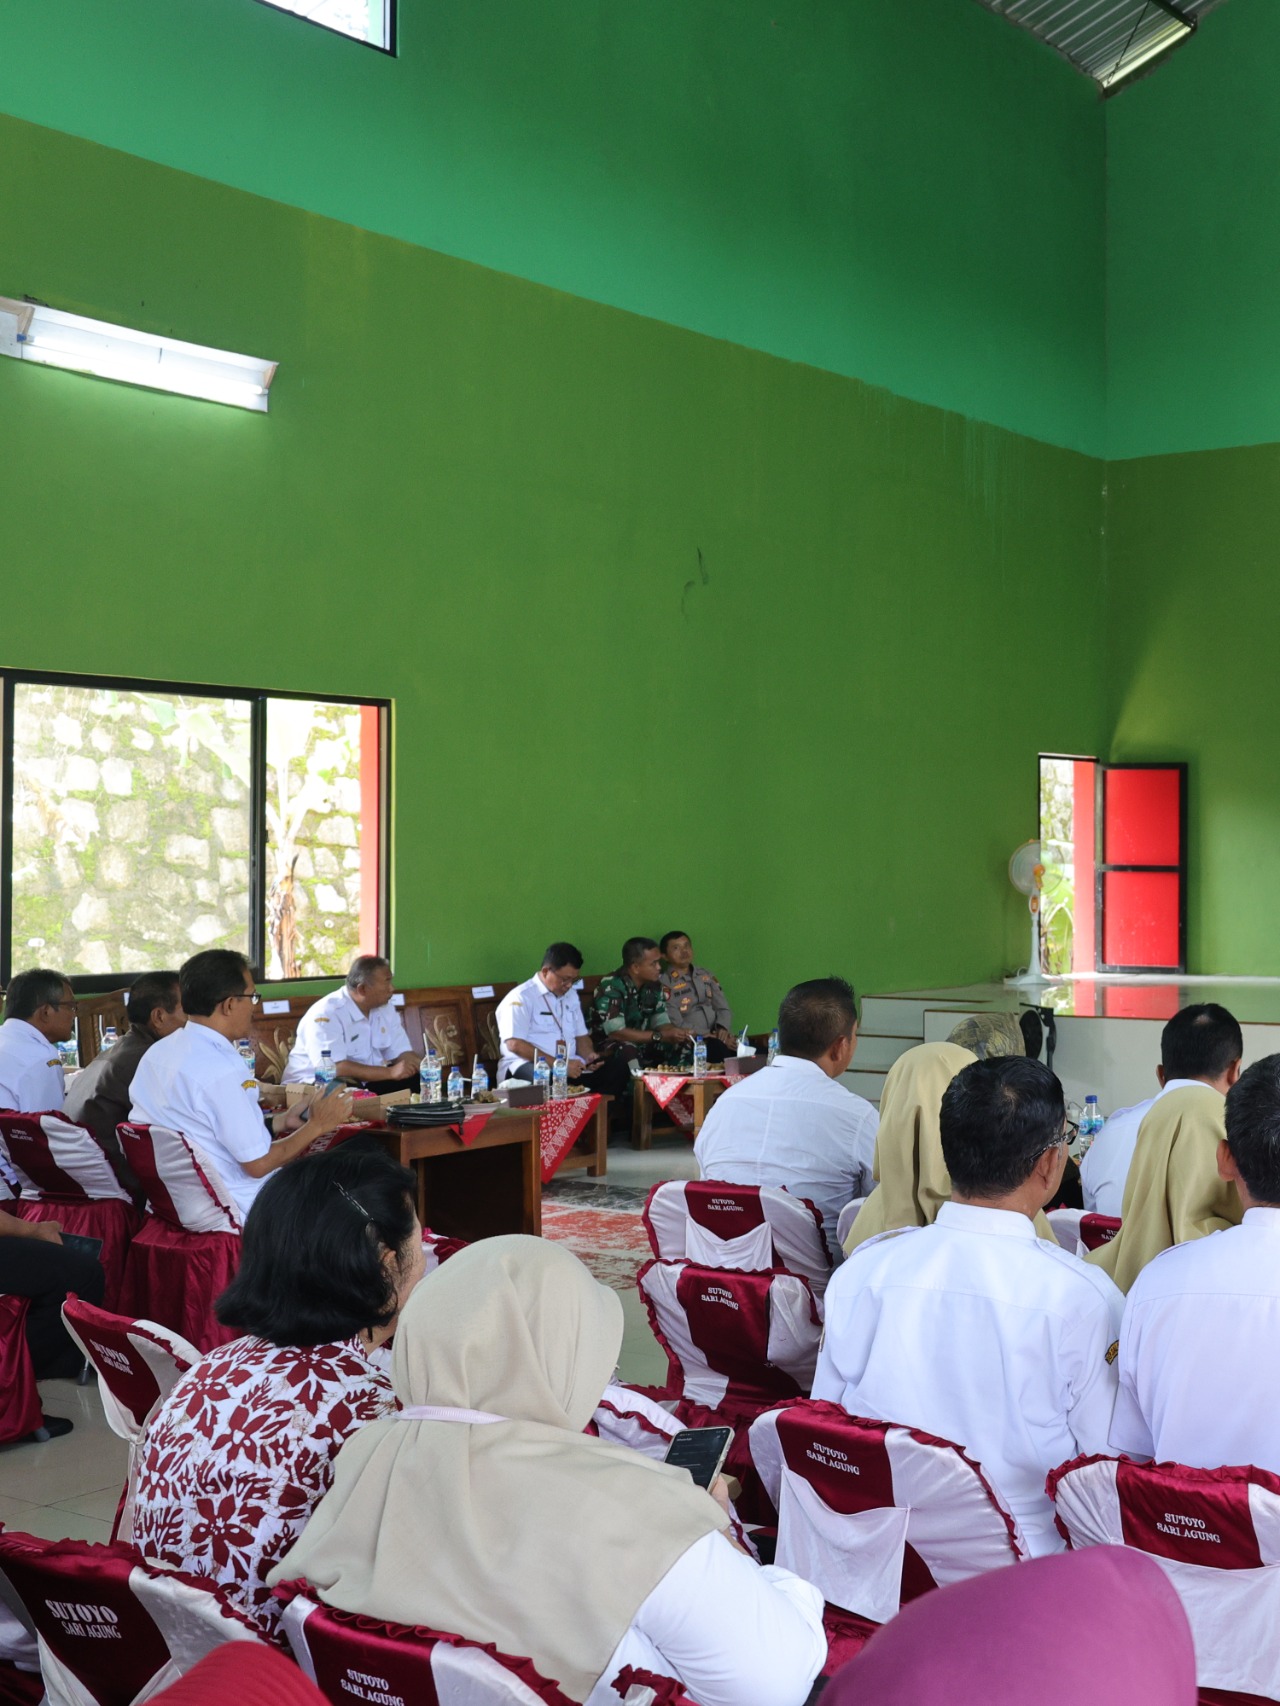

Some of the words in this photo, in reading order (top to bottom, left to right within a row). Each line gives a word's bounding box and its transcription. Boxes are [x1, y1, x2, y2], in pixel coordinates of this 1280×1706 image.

[708, 1287, 732, 1298] SUTOYO
[720, 1297, 739, 1310] AGUNG
[813, 1442, 847, 1461] SUTOYO
[806, 1450, 826, 1465] SARI
[829, 1459, 860, 1475] AGUNG
[1164, 1513, 1206, 1529] SUTOYO
[1156, 1522, 1180, 1536] SARI
[1184, 1529, 1221, 1543] AGUNG
[45, 1599, 118, 1623] SUTOYO
[61, 1620, 86, 1636] SARI
[86, 1624, 122, 1639] AGUNG
[347, 1669, 389, 1690] SUTOYO
[341, 1679, 365, 1698] SARI
[367, 1690, 405, 1706] AGUNG
